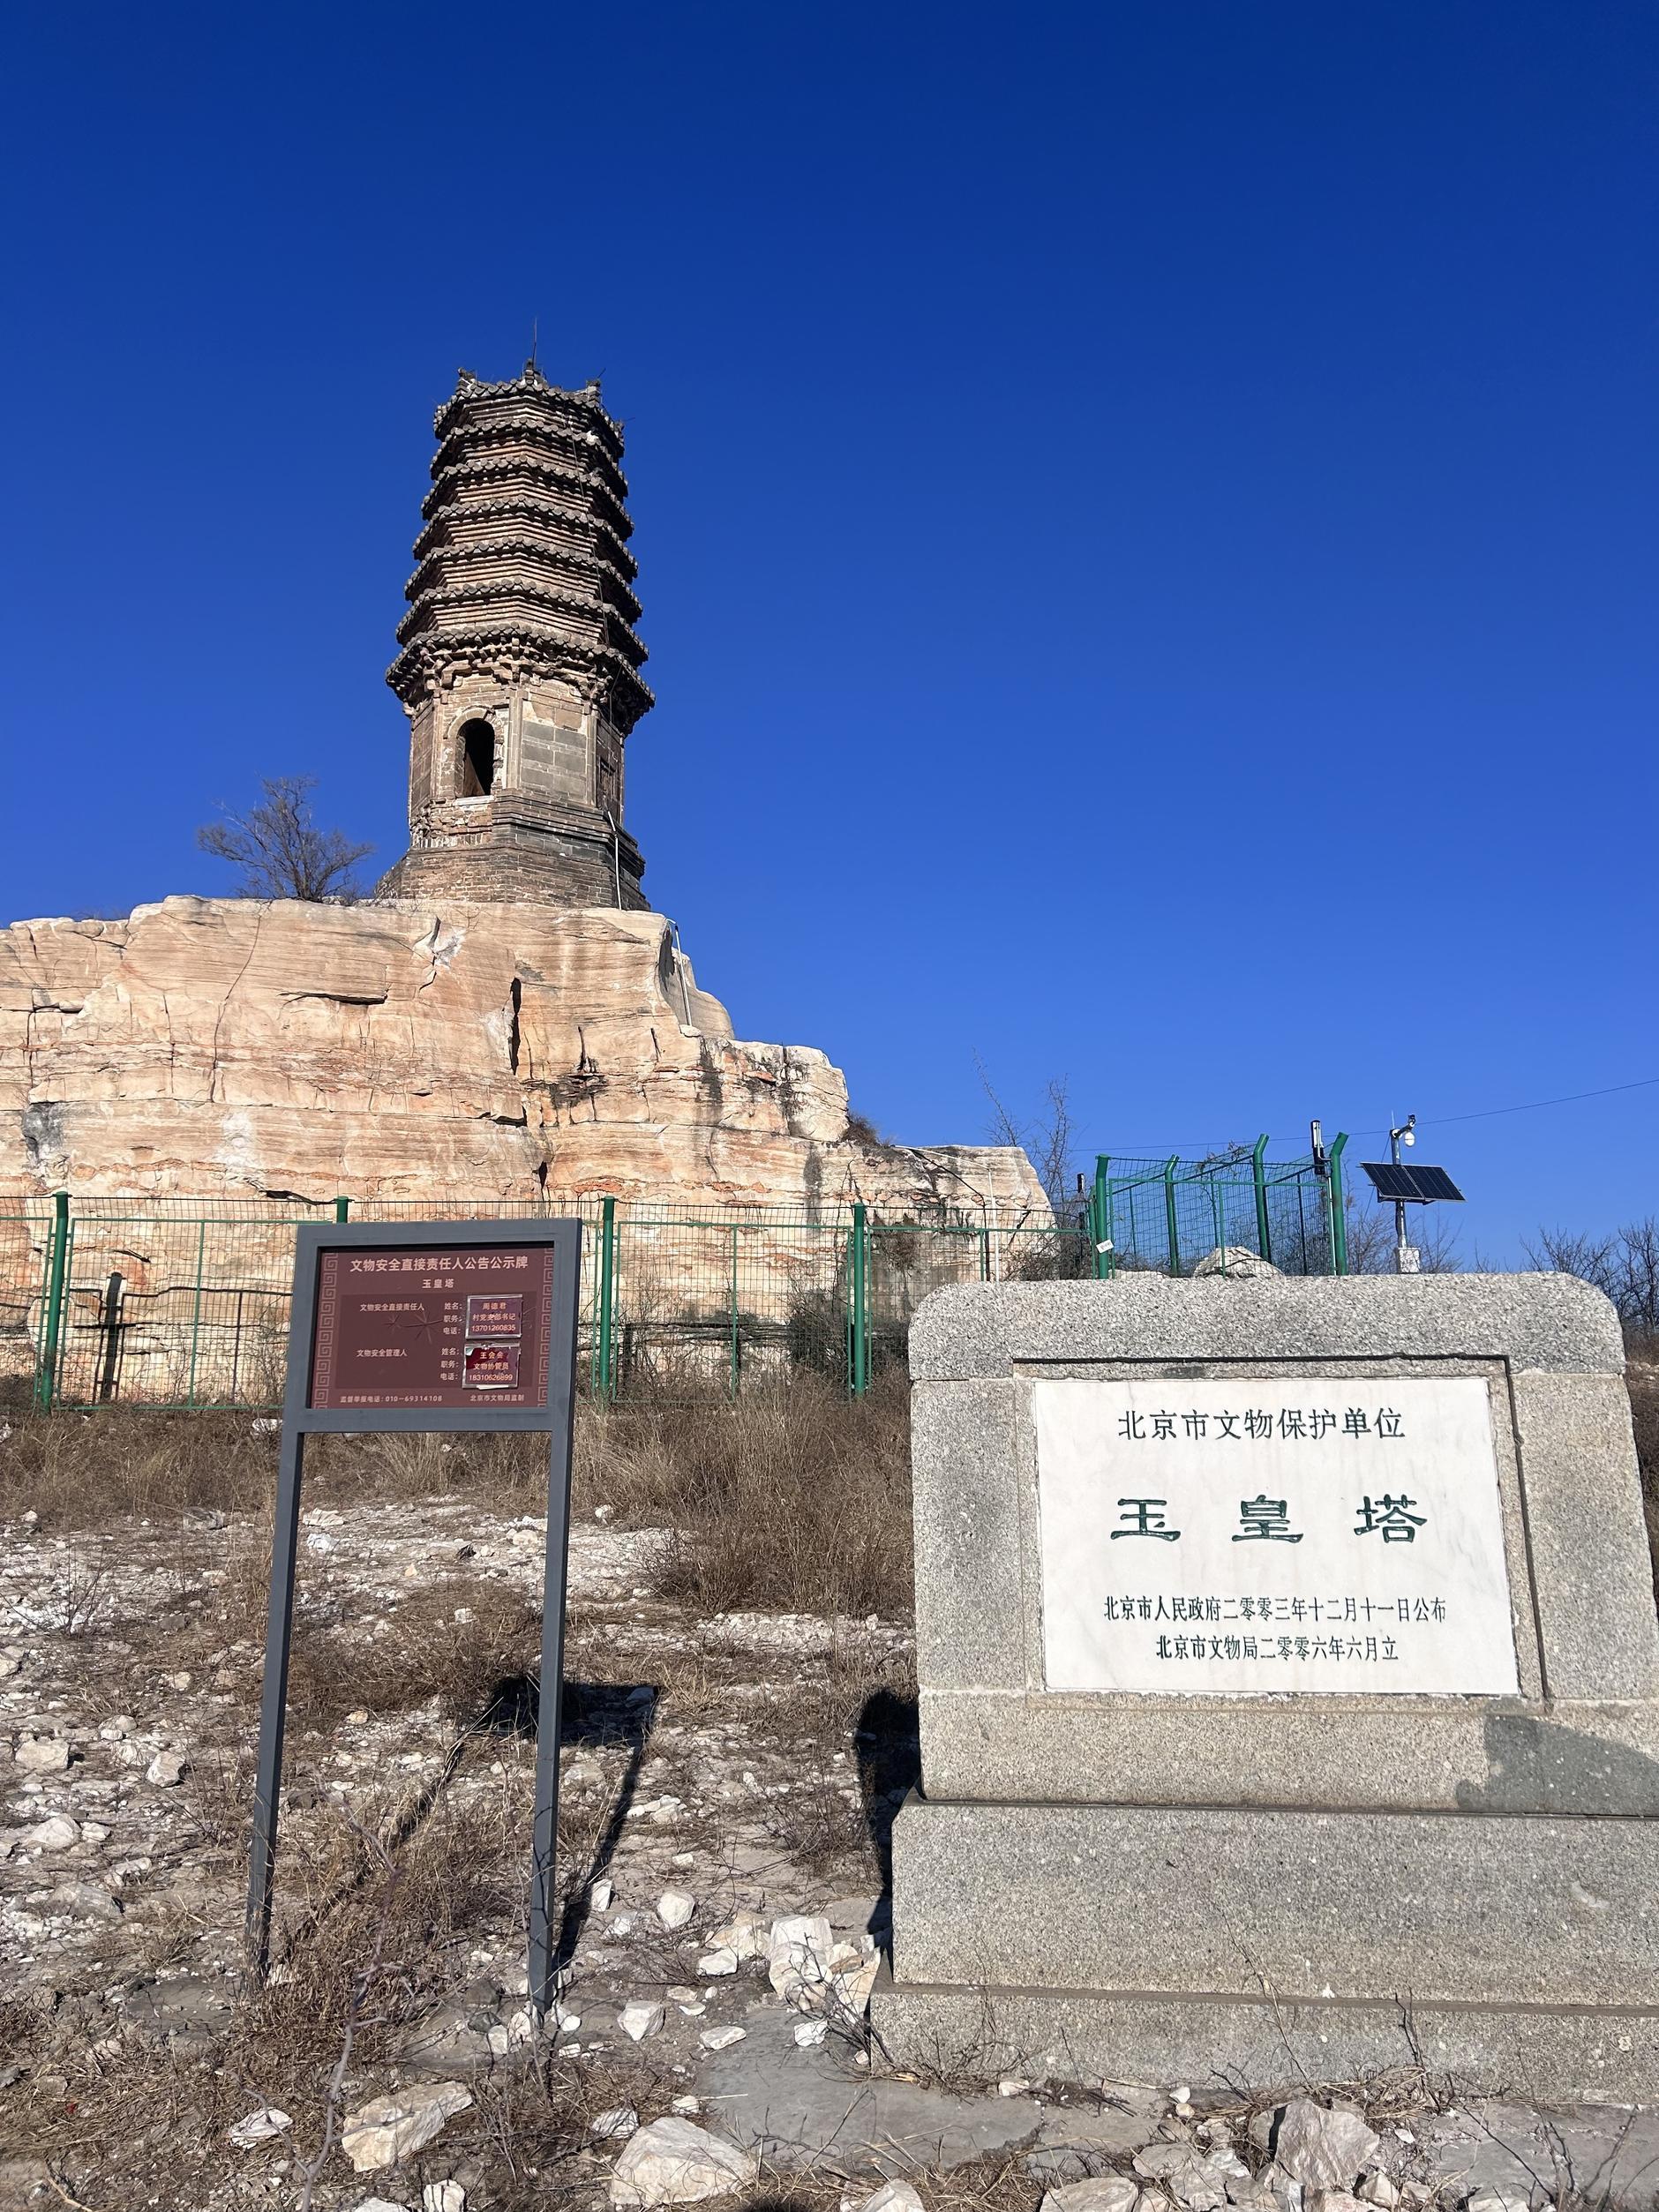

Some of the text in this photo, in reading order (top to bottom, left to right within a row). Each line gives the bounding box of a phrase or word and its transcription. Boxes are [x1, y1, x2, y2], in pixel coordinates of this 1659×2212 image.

[349, 1256, 529, 1272] 文物安全直接责任人公告公示牌
[422, 1278, 454, 1288] 玉皇塔
[1118, 1407, 1406, 1441] 北京市文物保护单位
[1104, 1595, 1446, 1623] 北京市人民政府二零零三年十二月十一日公布
[1156, 1634, 1400, 1662] 北京市文物局二零零六年六月立
